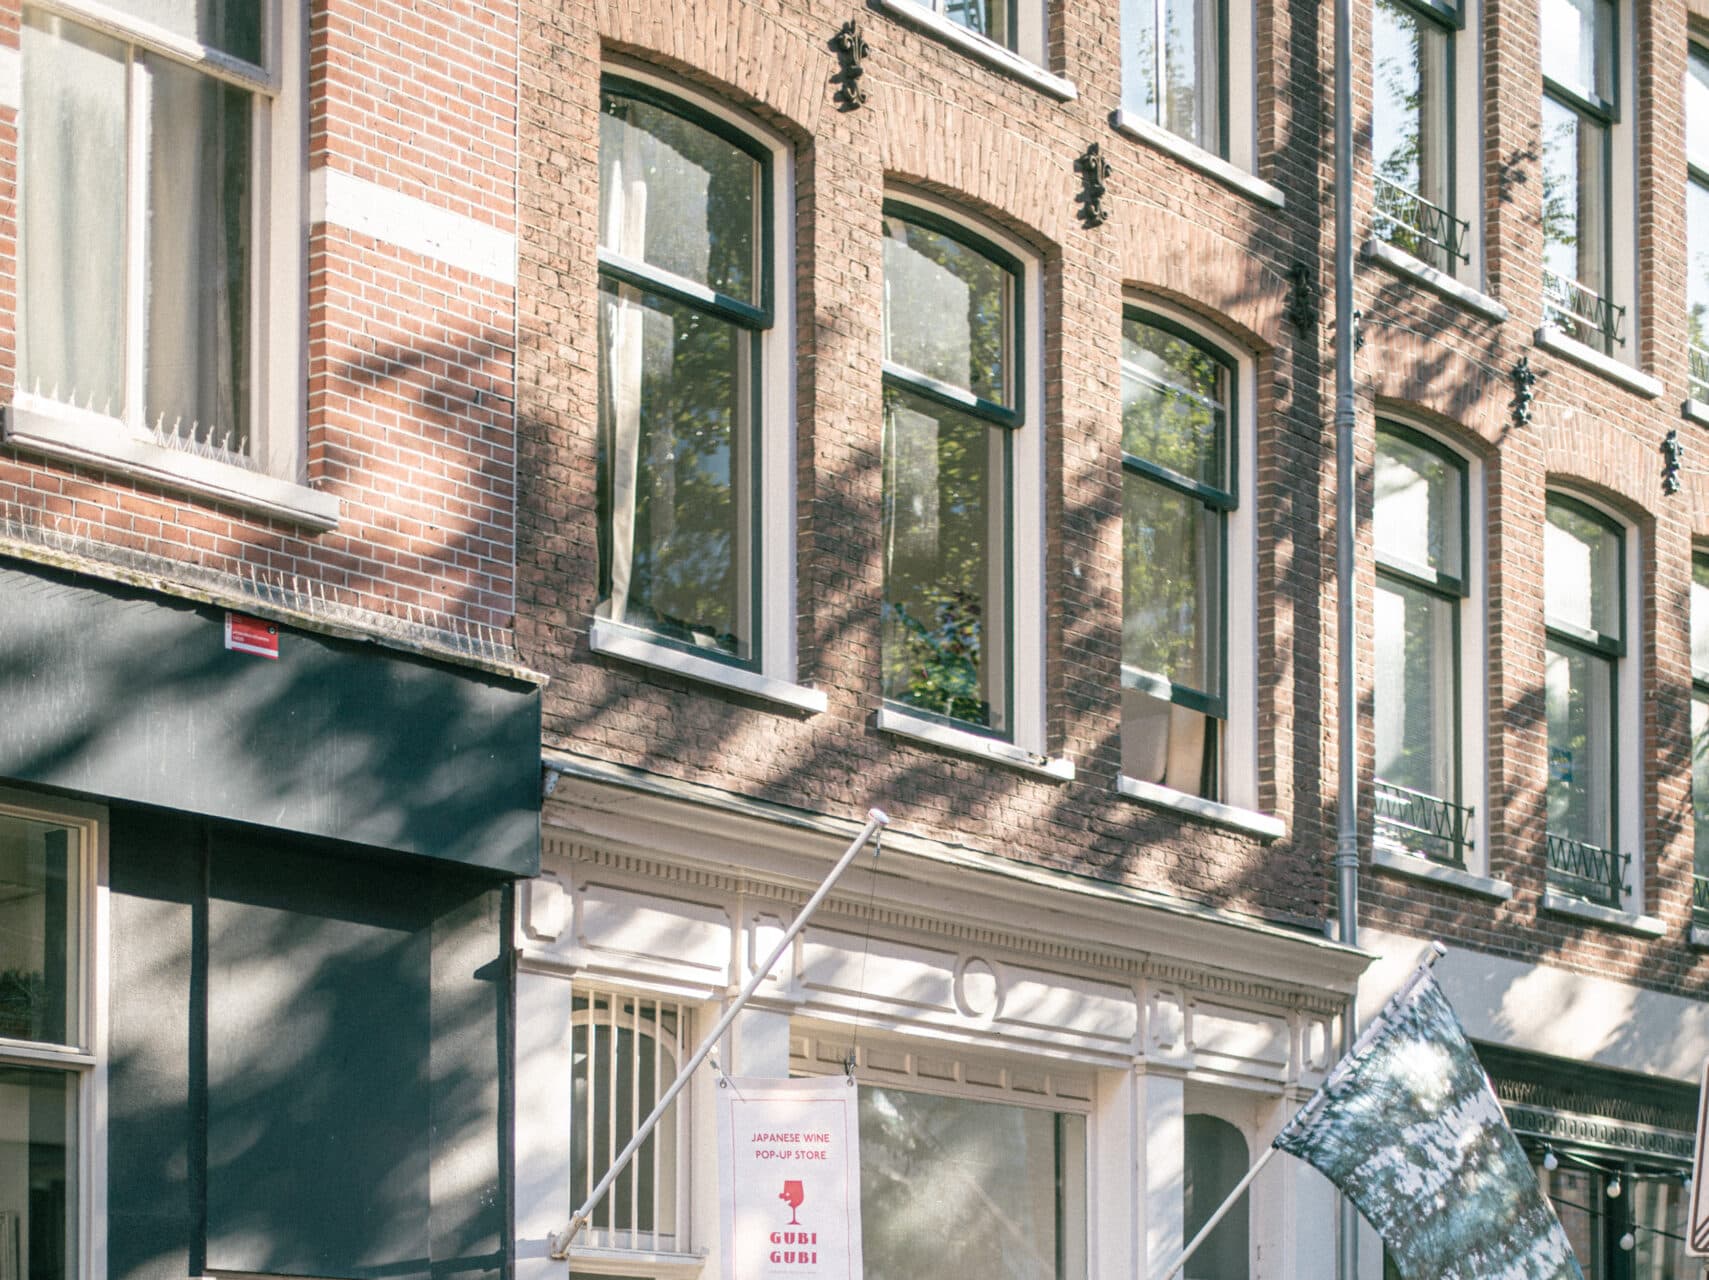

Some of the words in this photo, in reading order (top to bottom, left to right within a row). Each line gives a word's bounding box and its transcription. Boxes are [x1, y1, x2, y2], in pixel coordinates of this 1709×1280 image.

[751, 1133, 800, 1143] JAPANESE
[803, 1133, 830, 1143] WINE
[755, 1150, 792, 1160] POP-UP
[795, 1151, 827, 1160] STORE
[769, 1231, 817, 1245] GUBI
[769, 1250, 817, 1264] GUBI
